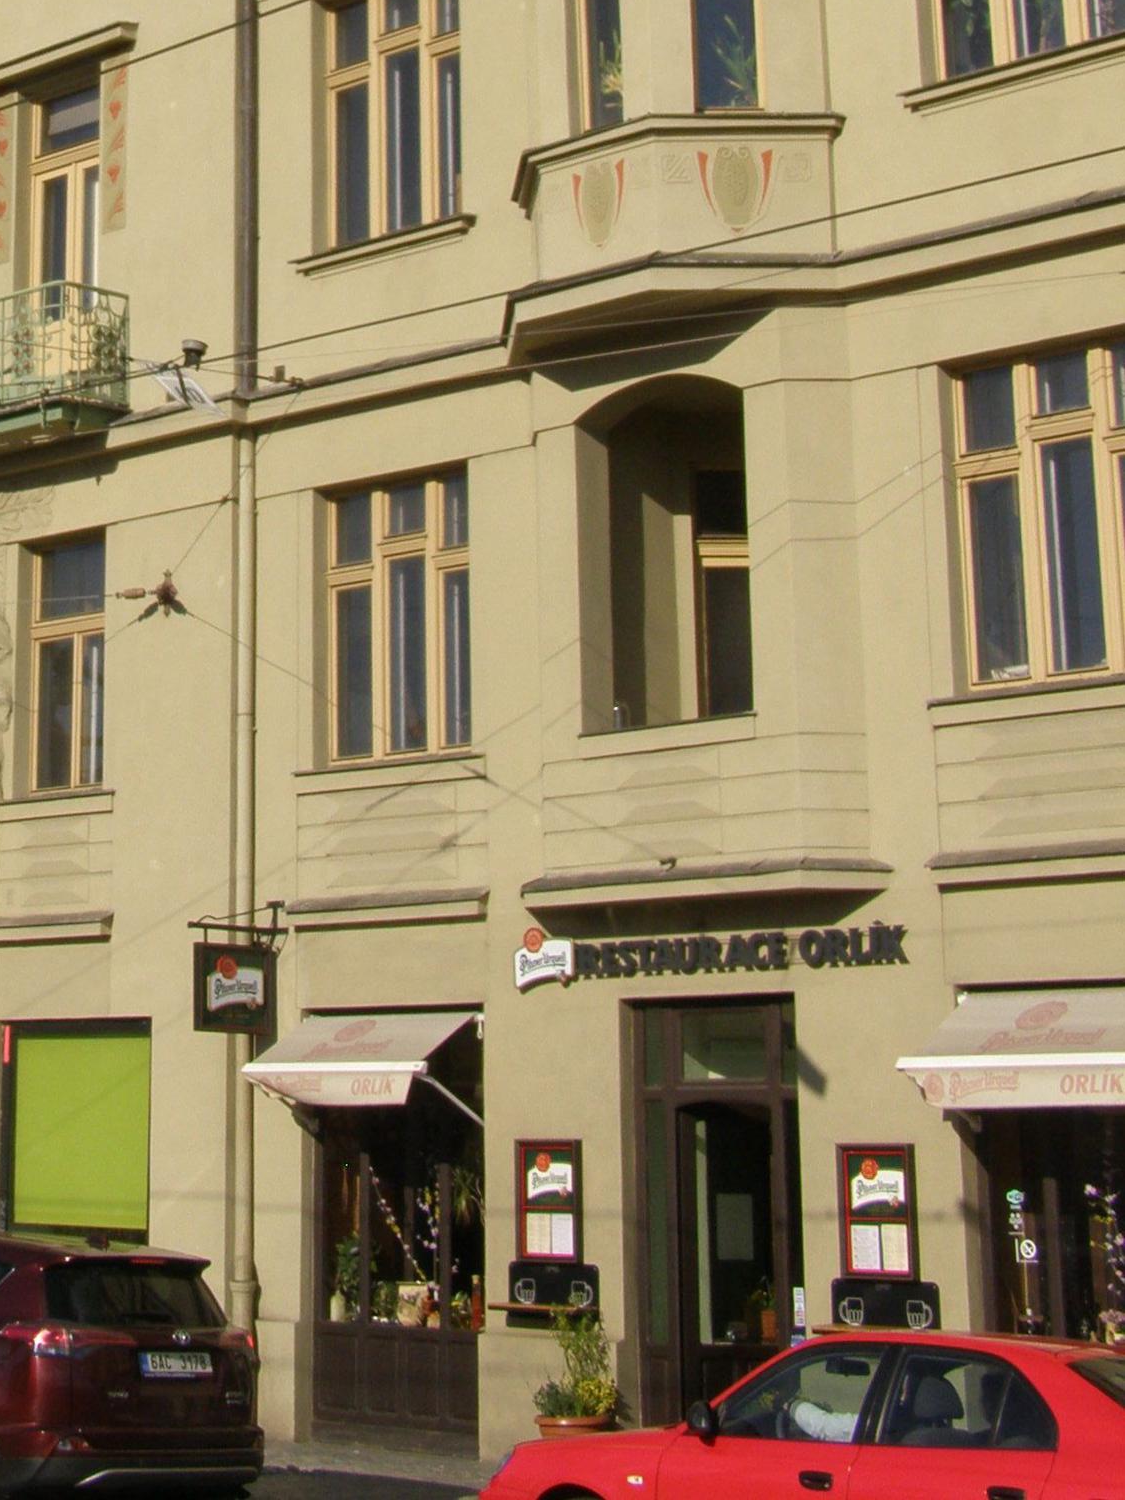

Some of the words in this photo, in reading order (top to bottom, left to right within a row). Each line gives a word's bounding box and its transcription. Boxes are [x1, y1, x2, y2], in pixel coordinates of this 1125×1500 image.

[575, 931, 789, 980] RESTAURACE
[798, 919, 910, 969] ORLÍK
[350, 1074, 395, 1096] ORLÍK
[1059, 1067, 1124, 1095] ORLÍK
[151, 1354, 172, 1370] 6AC
